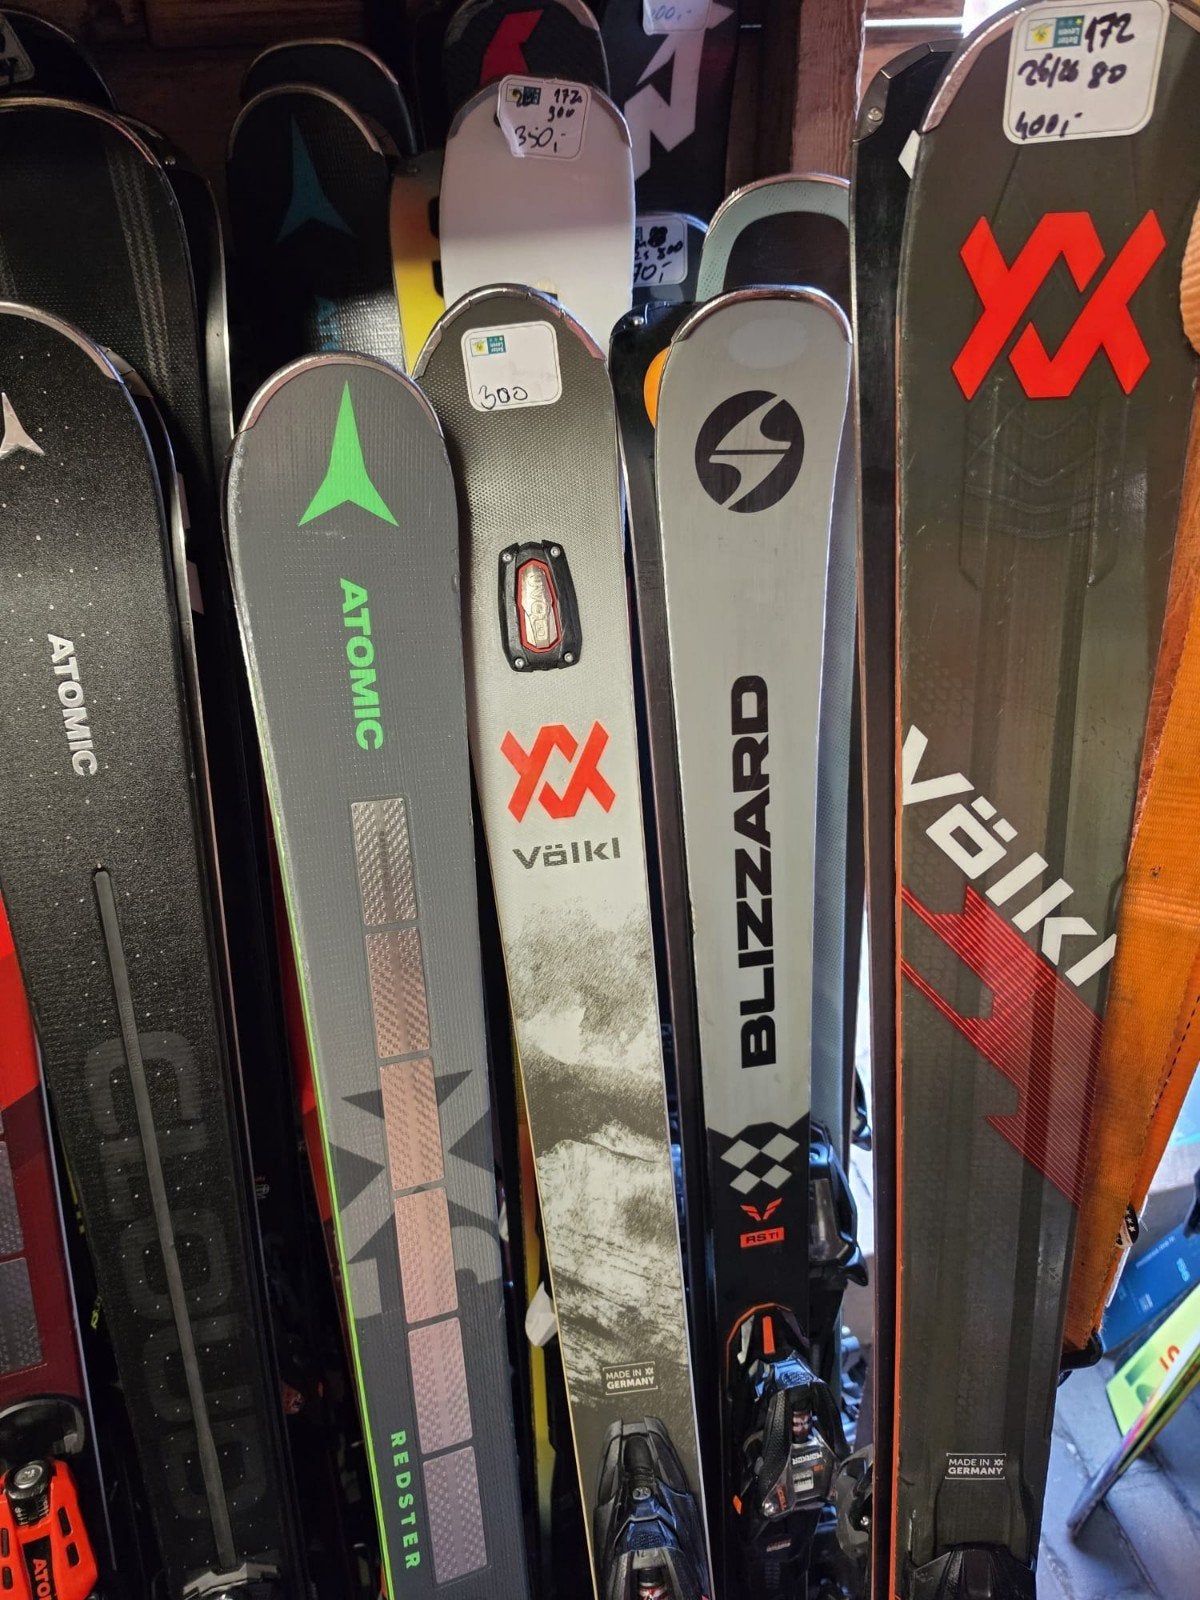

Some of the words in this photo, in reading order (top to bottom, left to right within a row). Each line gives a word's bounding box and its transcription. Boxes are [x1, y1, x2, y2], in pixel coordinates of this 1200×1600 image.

[1085, 12, 1135, 53] 172
[478, 384, 528, 410] 300
[340, 577, 384, 751] ATOMIC
[47, 633, 99, 777] ATOMIC
[512, 837, 620, 869] Völkl
[730, 674, 777, 1069] BLIZZARD
[901, 724, 1118, 987] Völkl
[606, 1370, 631, 1380] MADE
[632, 1368, 642, 1377] IN
[606, 1376, 655, 1390] GERMANY
[947, 1467, 1003, 1475] GERMANY
[948, 1458, 978, 1467] MADE
[979, 1458, 990, 1467] IN
[391, 1430, 421, 1569] REDSTER
[33, 1559, 54, 1600] ATO
